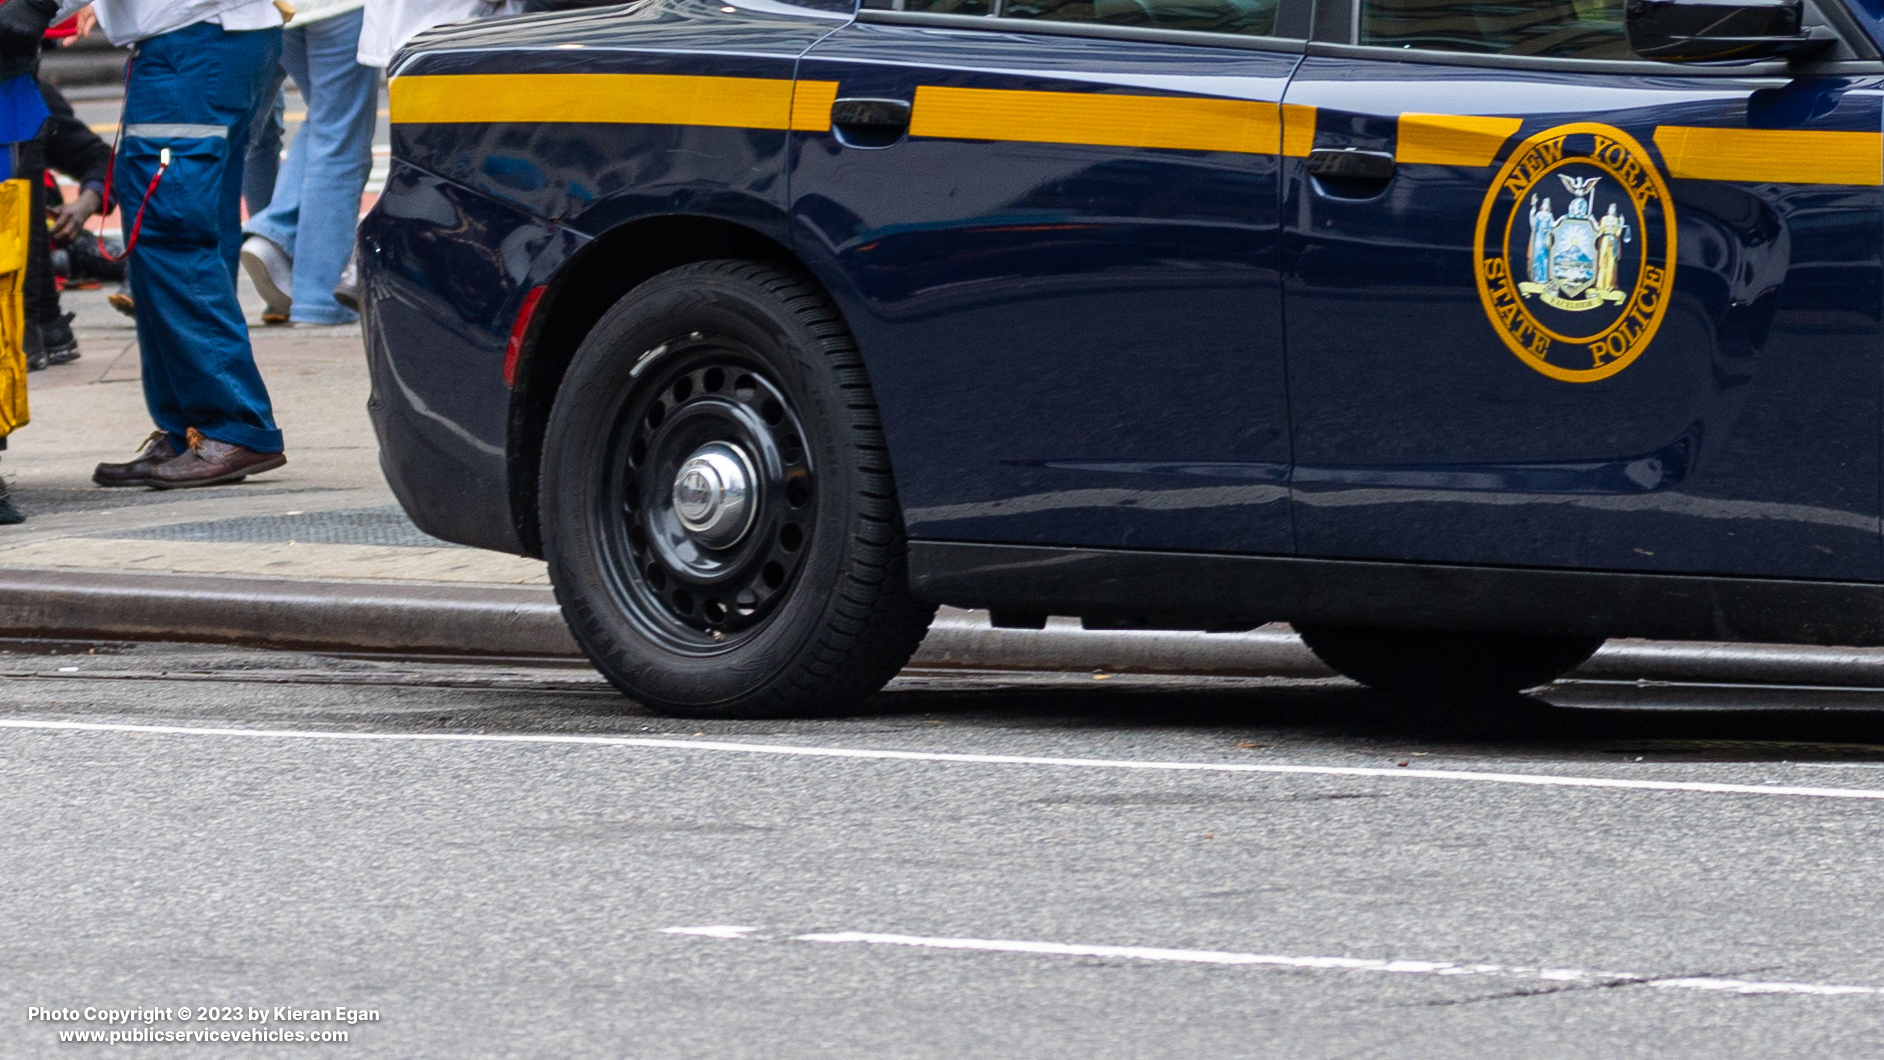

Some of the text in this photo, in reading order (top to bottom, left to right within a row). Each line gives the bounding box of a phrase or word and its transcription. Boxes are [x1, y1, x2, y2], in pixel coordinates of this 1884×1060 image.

[1503, 134, 1660, 211] NEW YORK
[1484, 256, 1666, 369] STATE POLICE
